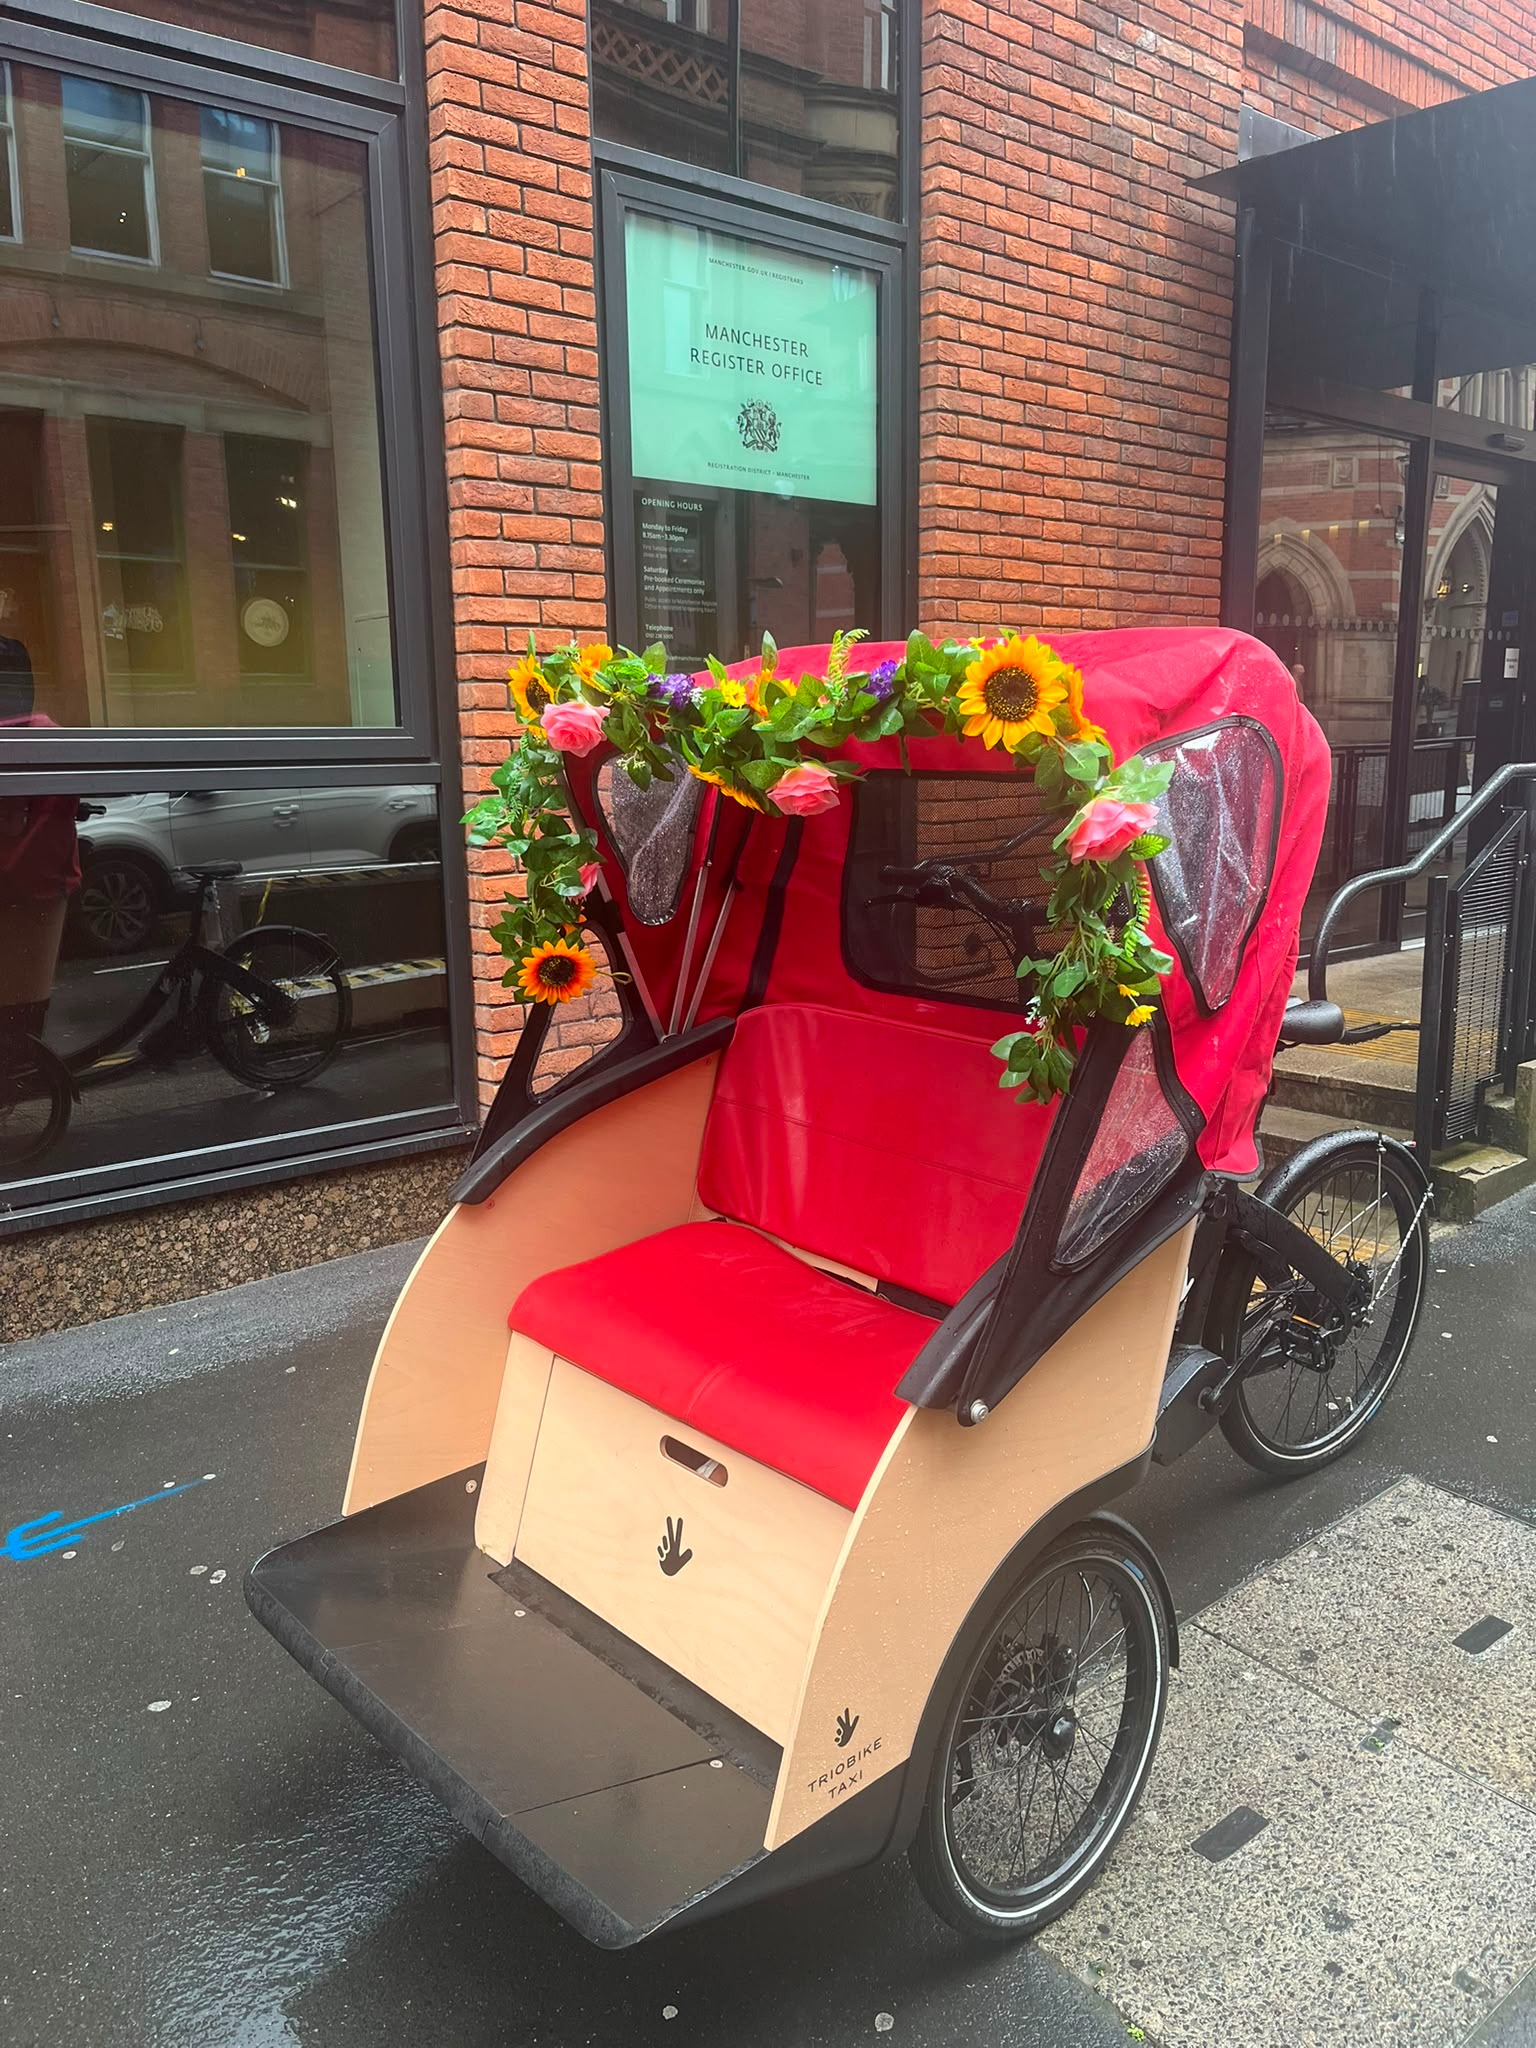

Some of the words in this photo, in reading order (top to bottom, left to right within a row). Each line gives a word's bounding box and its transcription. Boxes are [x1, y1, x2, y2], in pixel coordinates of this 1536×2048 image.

[704, 322, 809, 358] MANCHESTER
[690, 347, 766, 376] REGISTER
[771, 363, 823, 386] OFFICE
[707, 461, 747, 473] REGISTRATION
[747, 467, 771, 476] DISTRICT
[776, 471, 810, 481] MANCHESTER
[641, 497, 676, 509] OPENING
[676, 501, 703, 512] HOURS
[642, 522, 665, 533] Monday
[671, 525, 688, 535] Friday
[643, 565, 669, 576] Saturday
[643, 574, 674, 585] Pre-booked
[674, 576, 705, 587] Ceremonies
[644, 583, 655, 591] and
[655, 584, 693, 595] Appointments
[693, 587, 705, 596] only
[645, 623, 674, 633] Telephone
[807, 1736, 883, 1793] TRIOBIKE
[828, 1769, 863, 1800] TAXI
